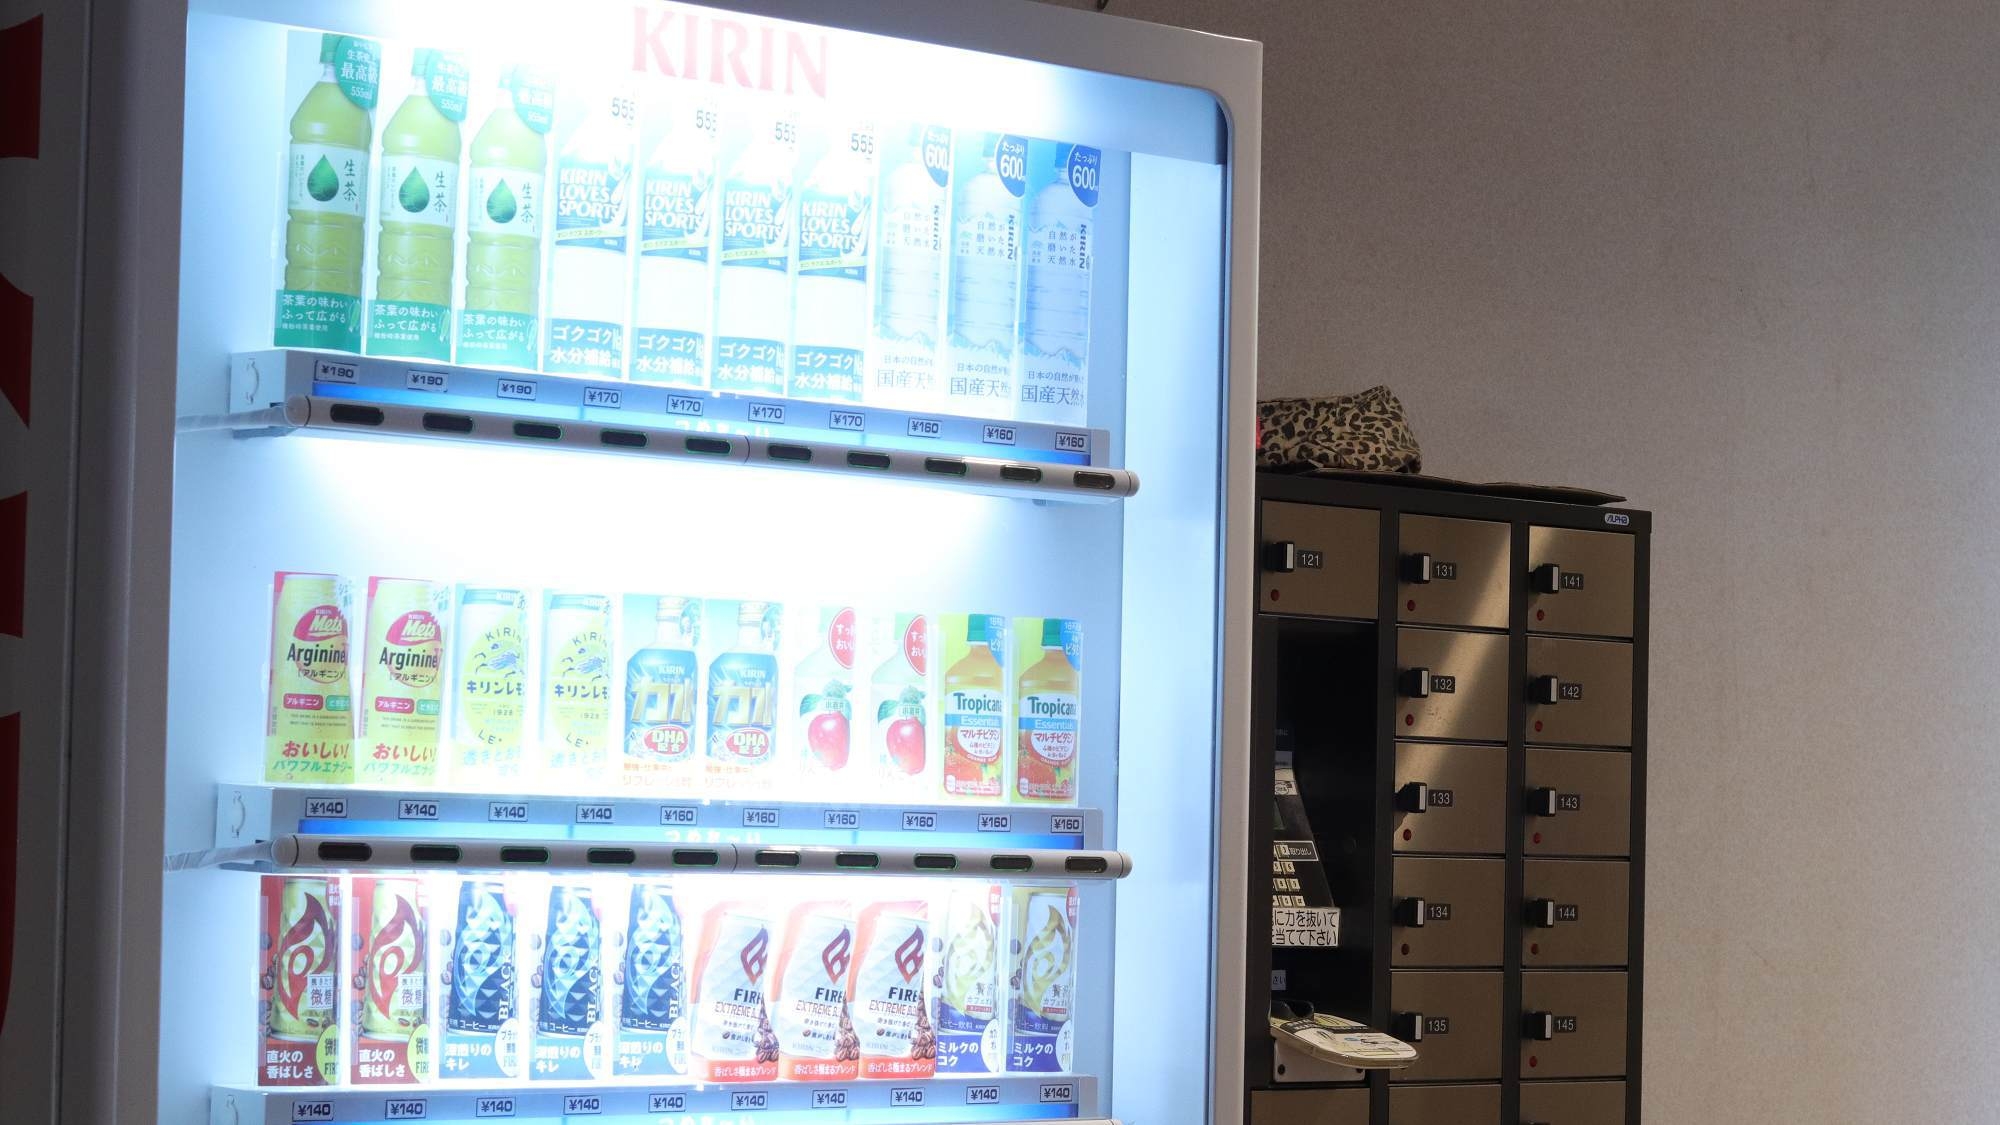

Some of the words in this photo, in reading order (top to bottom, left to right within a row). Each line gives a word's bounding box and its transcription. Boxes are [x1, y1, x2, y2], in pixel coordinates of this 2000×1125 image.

[632, 5, 828, 99] KIRIN
[343, 159, 358, 202] 生茶
[560, 168, 606, 185] KIRIN
[434, 171, 448, 214] 生茶
[560, 184, 610, 202] LOVES
[646, 180, 692, 197] KIRIN
[520, 182, 534, 224] 生茶
[646, 196, 694, 213] LOVES
[727, 192, 770, 207] KIRIN
[559, 202, 622, 221] SPORTS
[726, 206, 774, 222] LOVES
[802, 202, 848, 218] KIRIN
[645, 212, 704, 230] SPORTS
[802, 217, 850, 233] LOVES
[725, 222, 783, 239] SPORTS
[801, 232, 863, 250] SPORTS
[282, 294, 348, 309] 茶葉の味わい
[282, 310, 346, 324] ふって広がる
[374, 304, 438, 318] 茶葉の味わい
[375, 320, 436, 334] ふって広がる
[464, 314, 526, 328] 茶葉の味わい
[464, 330, 525, 342] ふって広がる
[321, 366, 354, 378] ¥190
[411, 373, 444, 386] ¥190
[502, 382, 532, 395] ¥190
[589, 391, 619, 404] ¥170
[672, 399, 701, 412] ¥170
[752, 406, 782, 420] ¥170
[834, 413, 862, 426] ¥170
[912, 420, 939, 434] ¥160
[986, 428, 1014, 442] ¥160
[1059, 435, 1084, 448] ¥160
[1302, 554, 1320, 566] 121
[1435, 564, 1454, 578] 131
[1562, 576, 1580, 588] 141
[287, 642, 346, 664] Arginine
[379, 646, 437, 670] Arginine
[1434, 678, 1452, 691] 132
[1562, 686, 1580, 698] 142
[652, 730, 684, 744] DHA
[734, 734, 765, 746] DHA
[282, 740, 350, 760] おいしい!
[1431, 792, 1450, 805] 133
[1560, 796, 1578, 808] 143
[310, 802, 344, 815] ¥140
[404, 804, 436, 817] ¥140
[494, 807, 526, 820] ¥140
[581, 808, 612, 820] ¥140
[664, 810, 694, 822] ¥160
[746, 811, 776, 824] ¥160
[828, 813, 857, 826] ¥160
[906, 814, 934, 828] ¥160
[981, 816, 1008, 829] ¥160
[1054, 818, 1080, 831] ¥160
[1272, 910, 1337, 927] に力を抜いて
[1429, 906, 1448, 918] 134
[1558, 906, 1576, 919] 144
[1272, 928, 1336, 946] 当てて下さい
[714, 1002, 750, 1018] EXTREME
[795, 1000, 830, 1017] EXTREME
[868, 1000, 907, 1016] EXTREME
[1428, 1019, 1446, 1032] 135
[1556, 1018, 1574, 1032] 145
[938, 1041, 979, 1054] ミルクの
[1014, 1042, 1054, 1055] ミルクの
[268, 1050, 302, 1062] 直火の
[359, 1049, 395, 1062] 直火の
[620, 1055, 645, 1068] キレ
[937, 1055, 958, 1066] コク
[1014, 1056, 1034, 1068] コク
[359, 1065, 406, 1078] 香ばしさ
[446, 1058, 470, 1072] キレ
[536, 1059, 560, 1073] キレ
[268, 1066, 313, 1078] 香ばしさ
[817, 1092, 846, 1105] ¥140
[895, 1090, 922, 1103] ¥140
[970, 1088, 998, 1100] ¥140
[1044, 1087, 1070, 1100] ¥140
[481, 1100, 514, 1112] ¥140
[568, 1098, 600, 1110] ¥140
[653, 1096, 684, 1109] ¥140
[736, 1094, 765, 1107] ¥140
[298, 1103, 332, 1116] ¥140
[390, 1102, 424, 1115] ¥140
